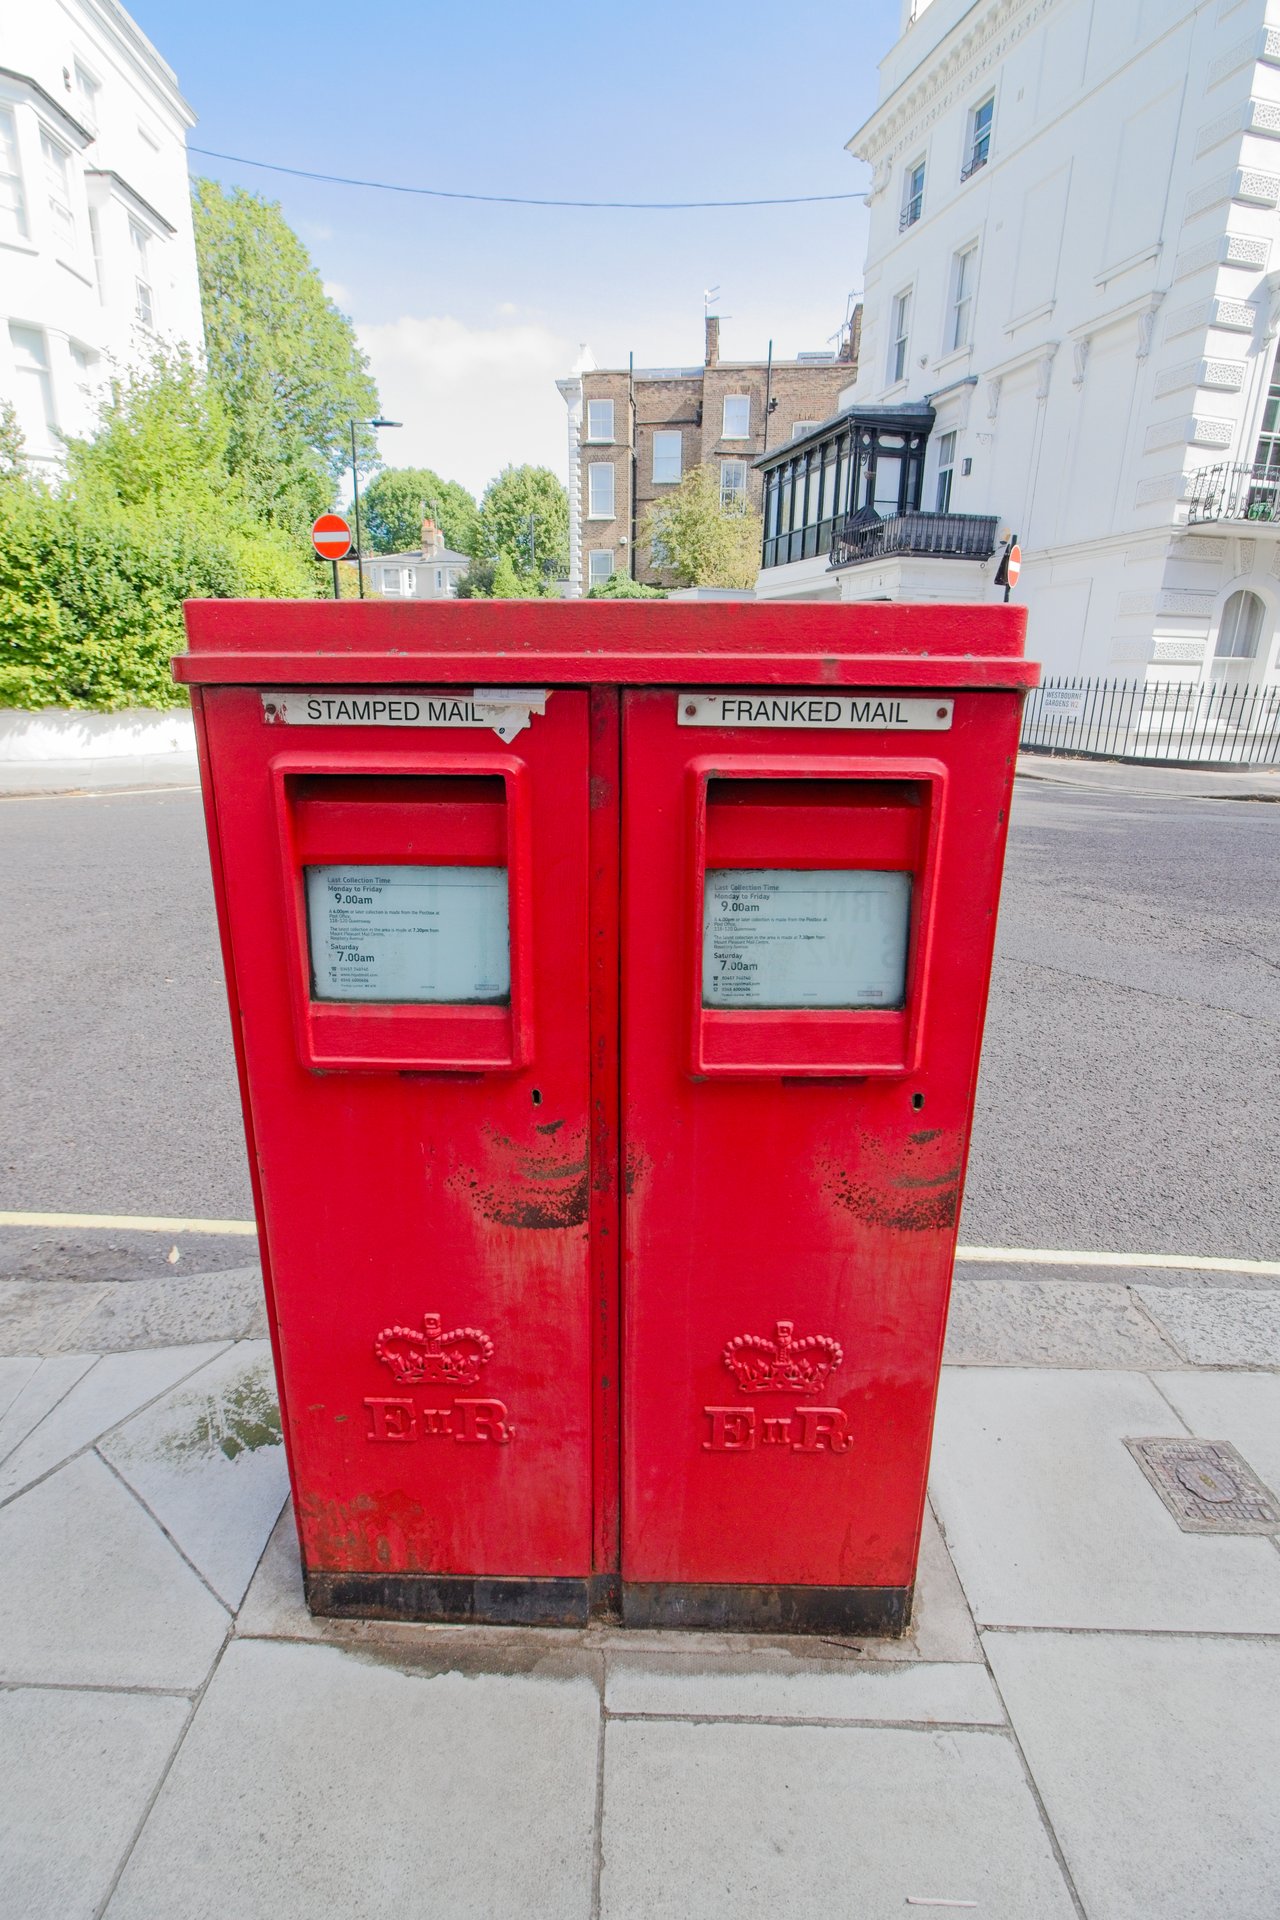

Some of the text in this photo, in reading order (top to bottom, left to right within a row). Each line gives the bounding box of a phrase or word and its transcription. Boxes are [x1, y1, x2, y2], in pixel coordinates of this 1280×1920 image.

[1046, 692, 1082, 700] WESTBOURNE
[1045, 700, 1070, 708] GARDENS
[308, 700, 484, 722] STAMPED MAIL
[722, 700, 908, 723] FRANKED MAIL
[334, 893, 373, 904] 9.00am
[721, 901, 760, 912] 9.00am
[337, 951, 375, 962] 7.00am
[720, 960, 758, 971] 7.00am
